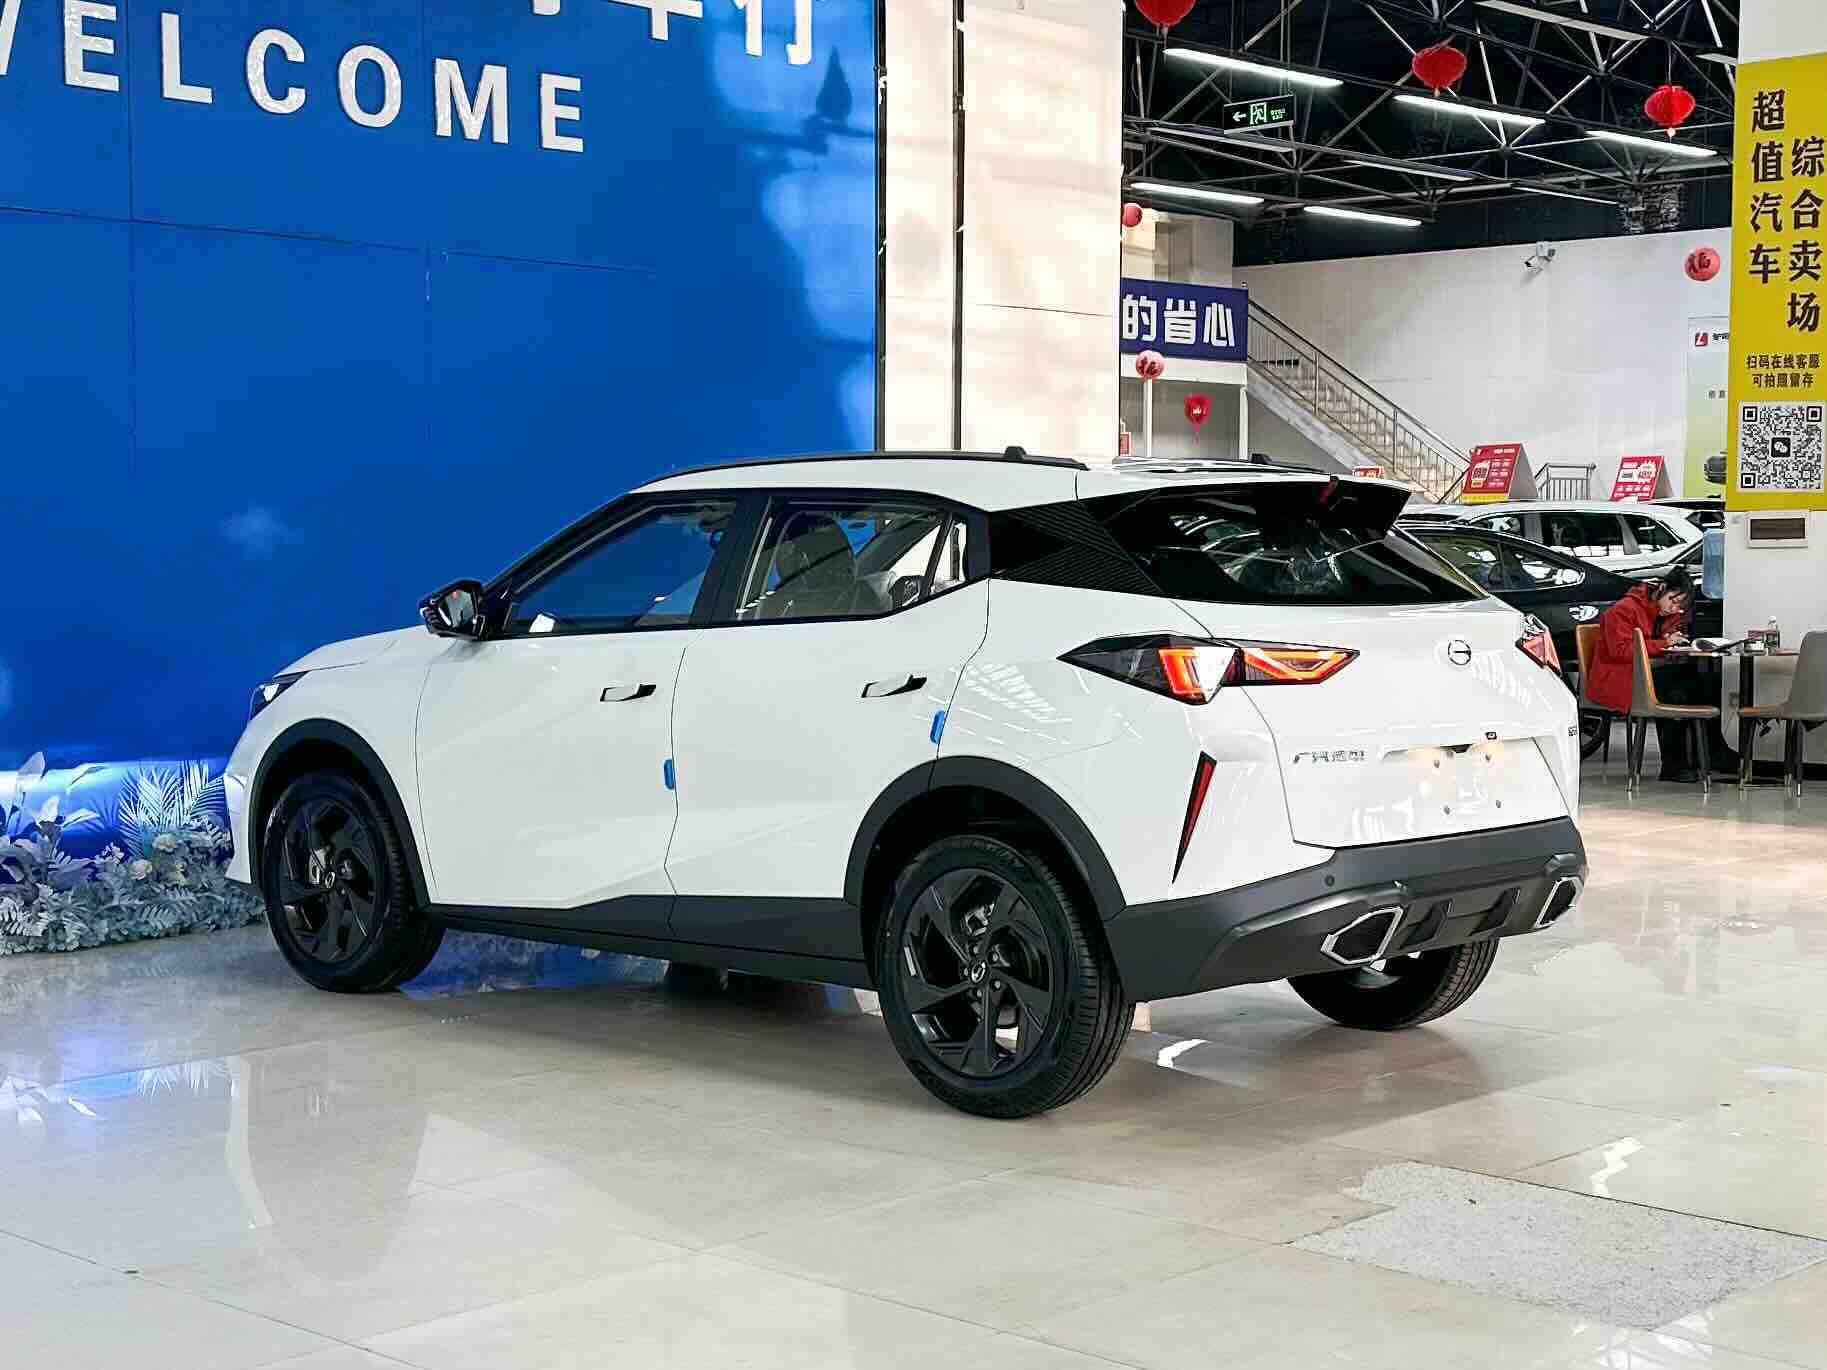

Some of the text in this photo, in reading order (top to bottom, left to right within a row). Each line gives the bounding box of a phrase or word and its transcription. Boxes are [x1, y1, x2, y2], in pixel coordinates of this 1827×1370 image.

[0, 0, 585, 153] ELCOME
[1749, 89, 1785, 284] 超值汽车
[1787, 136, 1825, 332] 综合卖场
[1122, 294, 1235, 347] 的省心
